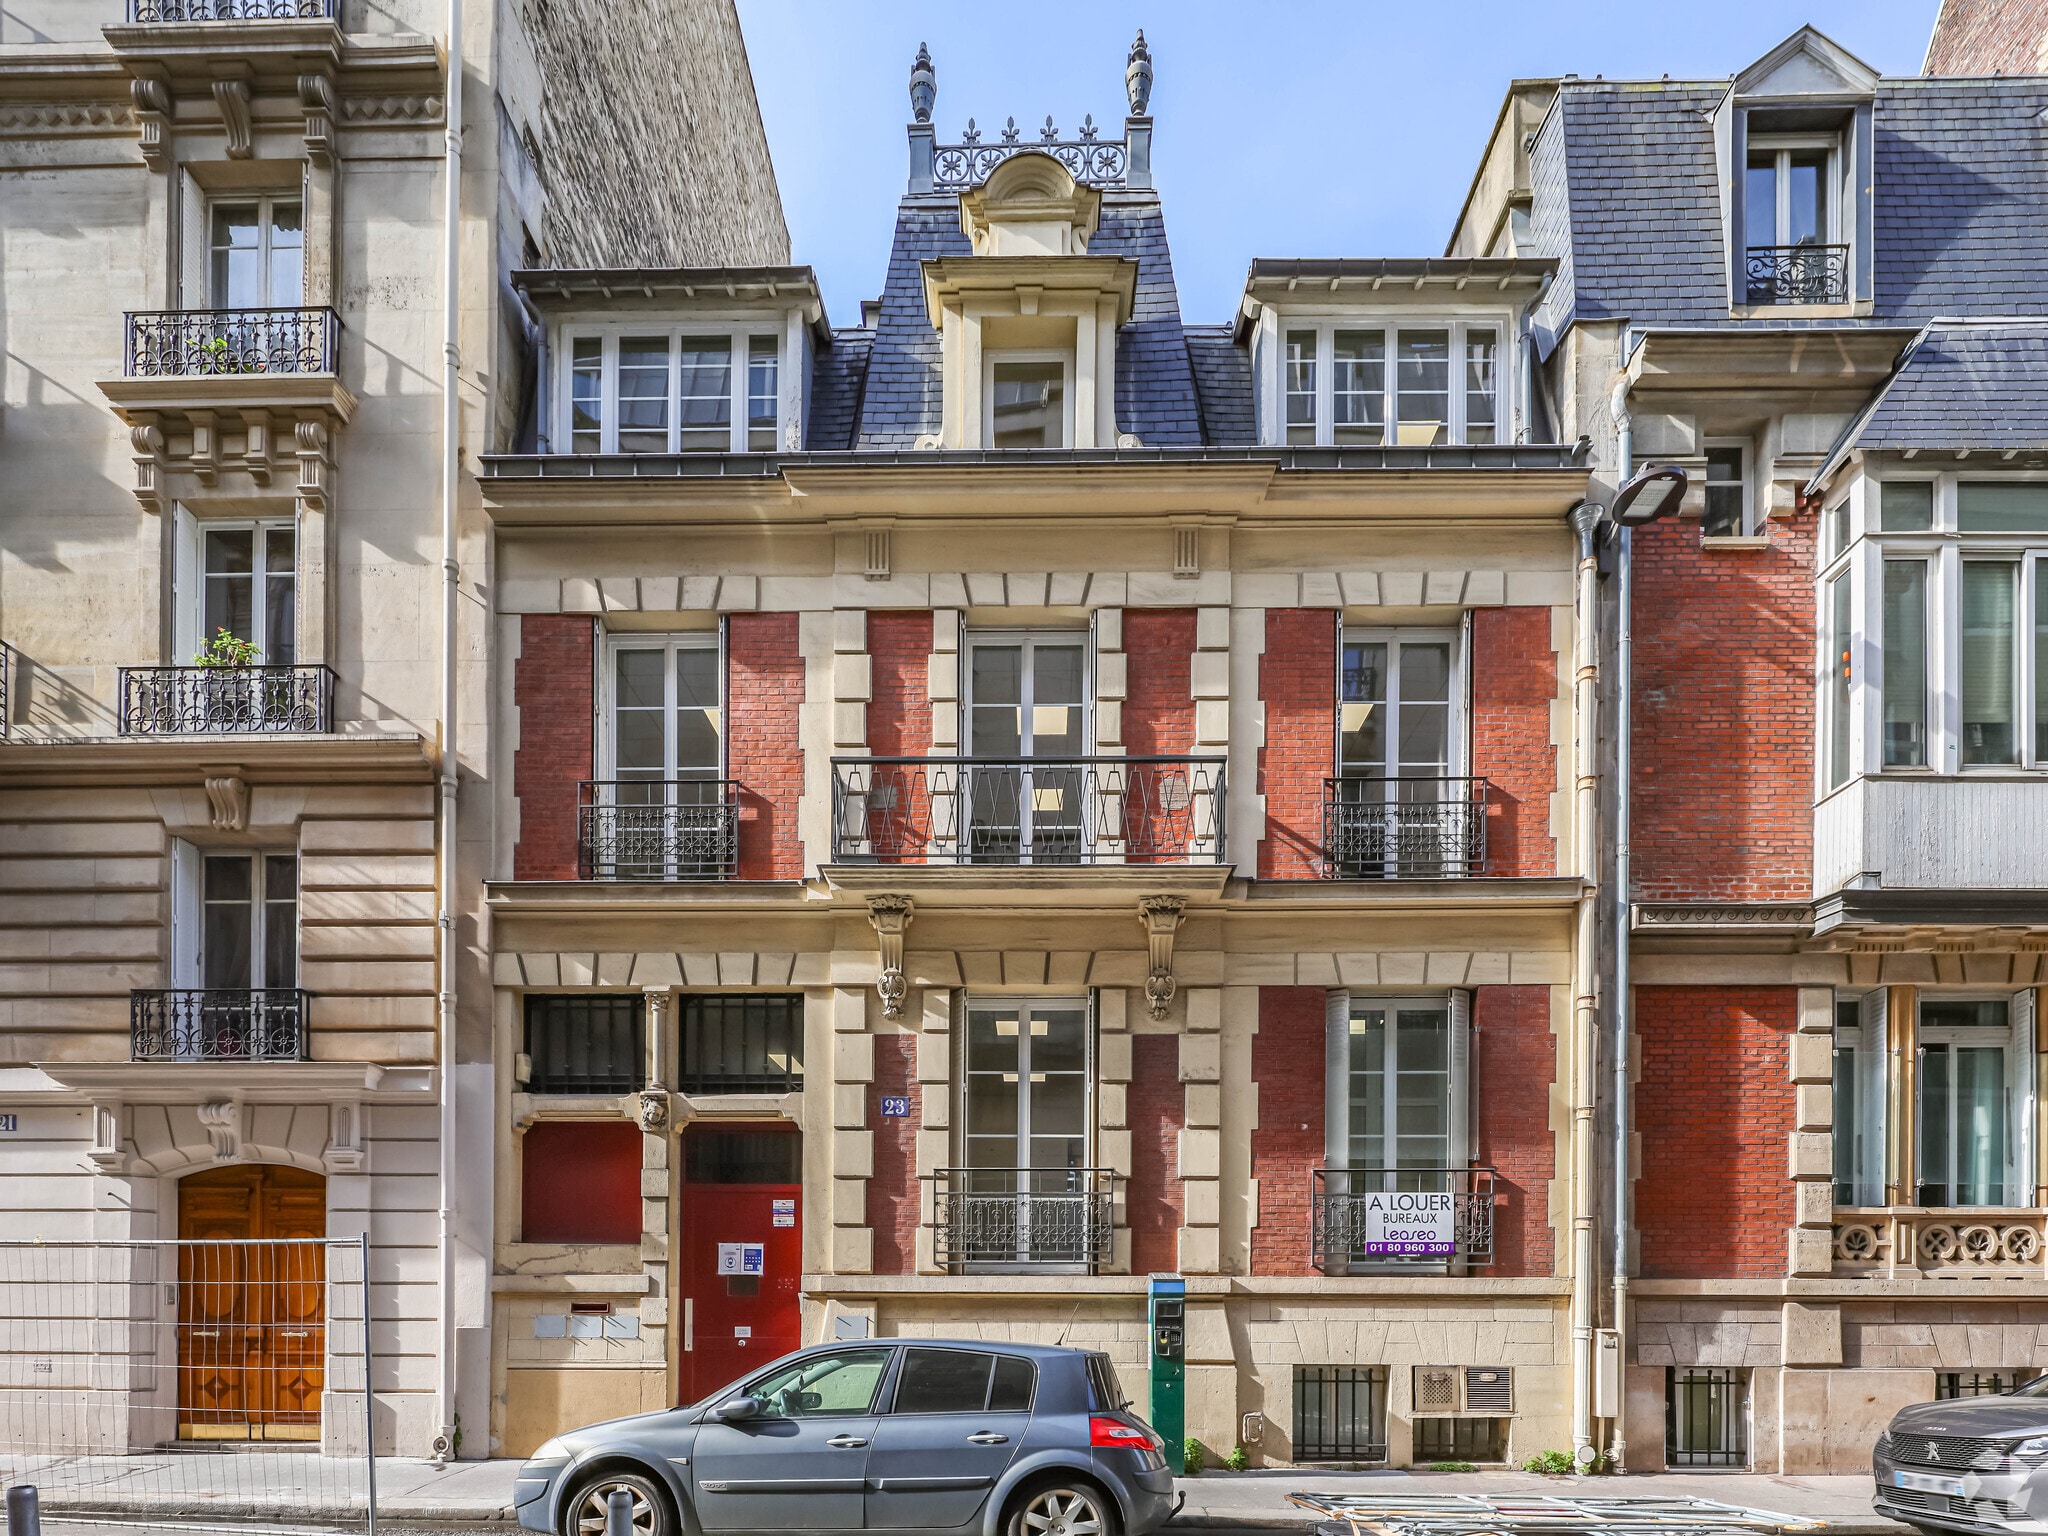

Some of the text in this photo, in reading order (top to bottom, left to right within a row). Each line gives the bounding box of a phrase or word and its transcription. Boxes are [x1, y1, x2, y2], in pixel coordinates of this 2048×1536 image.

[884, 1098, 905, 1115] 23
[1369, 1194, 1451, 1211] A LOUER
[1383, 1213, 1438, 1224] BUREAUX
[1370, 1243, 1450, 1252] 01 80 960 300
